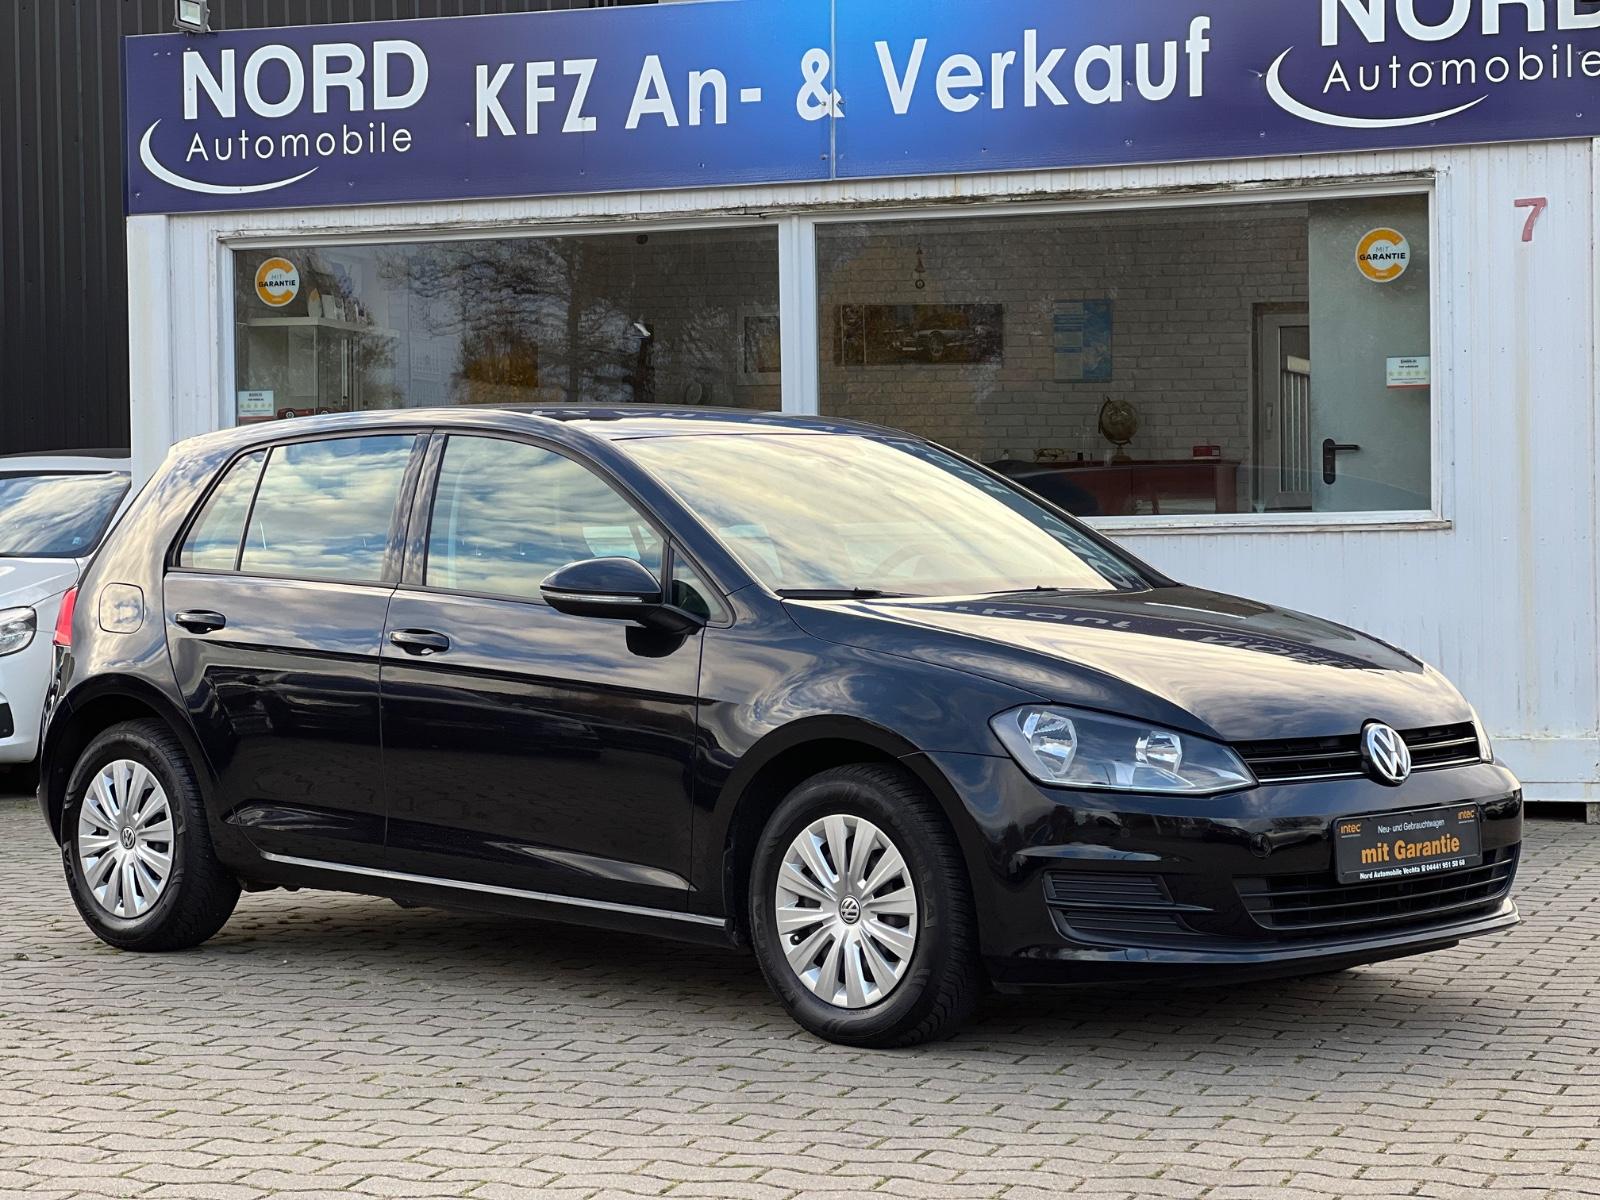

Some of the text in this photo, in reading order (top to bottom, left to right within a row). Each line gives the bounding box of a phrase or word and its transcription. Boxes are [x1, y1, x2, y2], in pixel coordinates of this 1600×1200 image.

[183, 39, 429, 120] NORD
[476, 16, 1210, 137] KFZ An- & Verkauf
[1323, 44, 1600, 94] Automobile
[186, 122, 412, 162] Automobile
[1513, 197, 1546, 242] 7
[1359, 252, 1406, 261] GARANTIE
[258, 280, 296, 288] GARANTIE
[1340, 823, 1361, 835] intec
[1392, 823, 1403, 832] und
[1403, 819, 1445, 830] Gebrauchtwagen
[1361, 833, 1460, 864] mit Garantie
[1359, 871, 1373, 880] Nord
[1373, 868, 1402, 878] Automobile
[1402, 866, 1420, 875] Vechta
